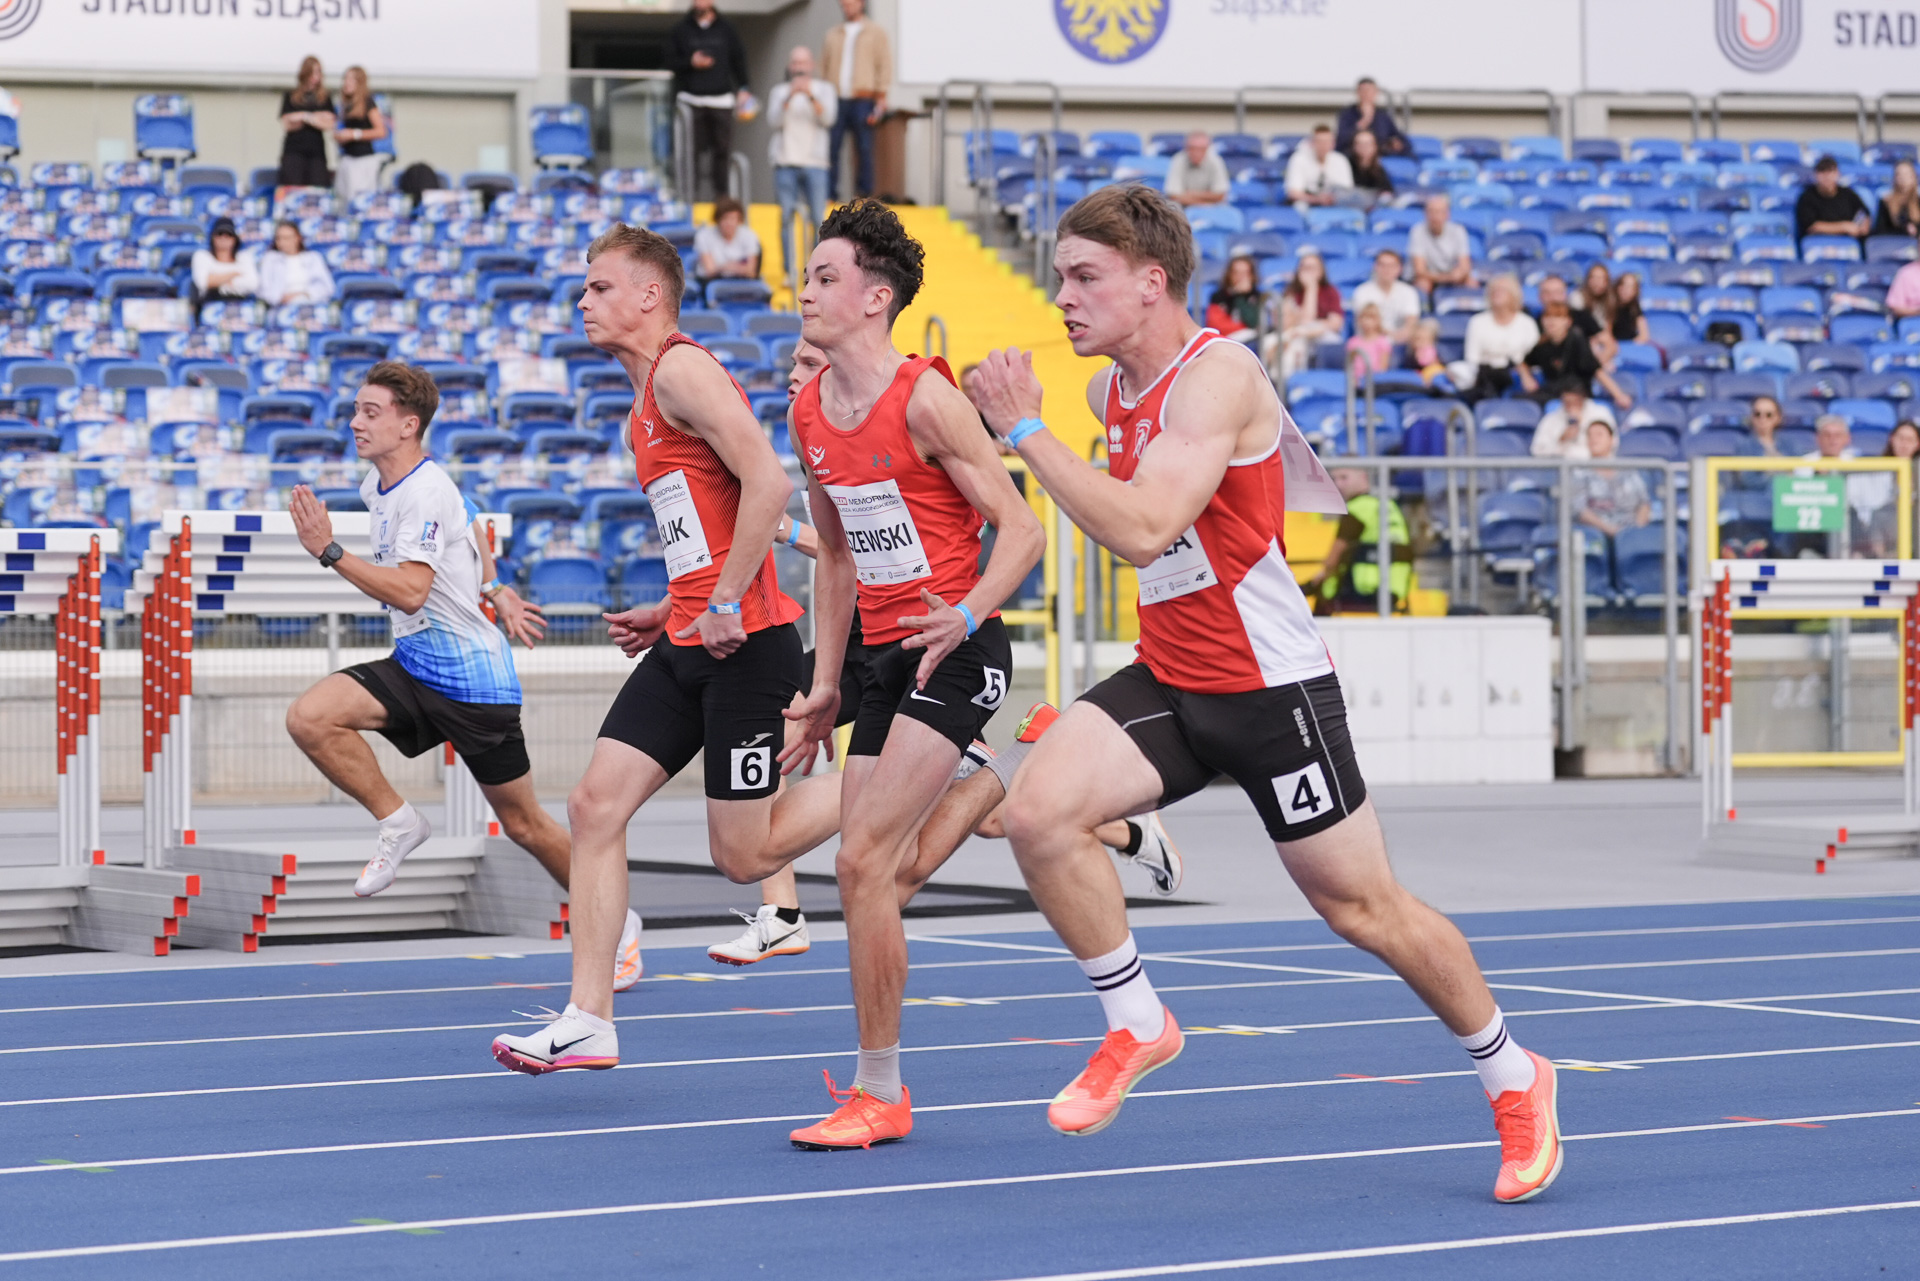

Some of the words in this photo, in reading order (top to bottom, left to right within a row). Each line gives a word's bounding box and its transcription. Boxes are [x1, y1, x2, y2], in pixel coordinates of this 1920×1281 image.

[981, 671, 1001, 705] 5
[740, 751, 763, 787] 6
[1291, 773, 1321, 813] 4
